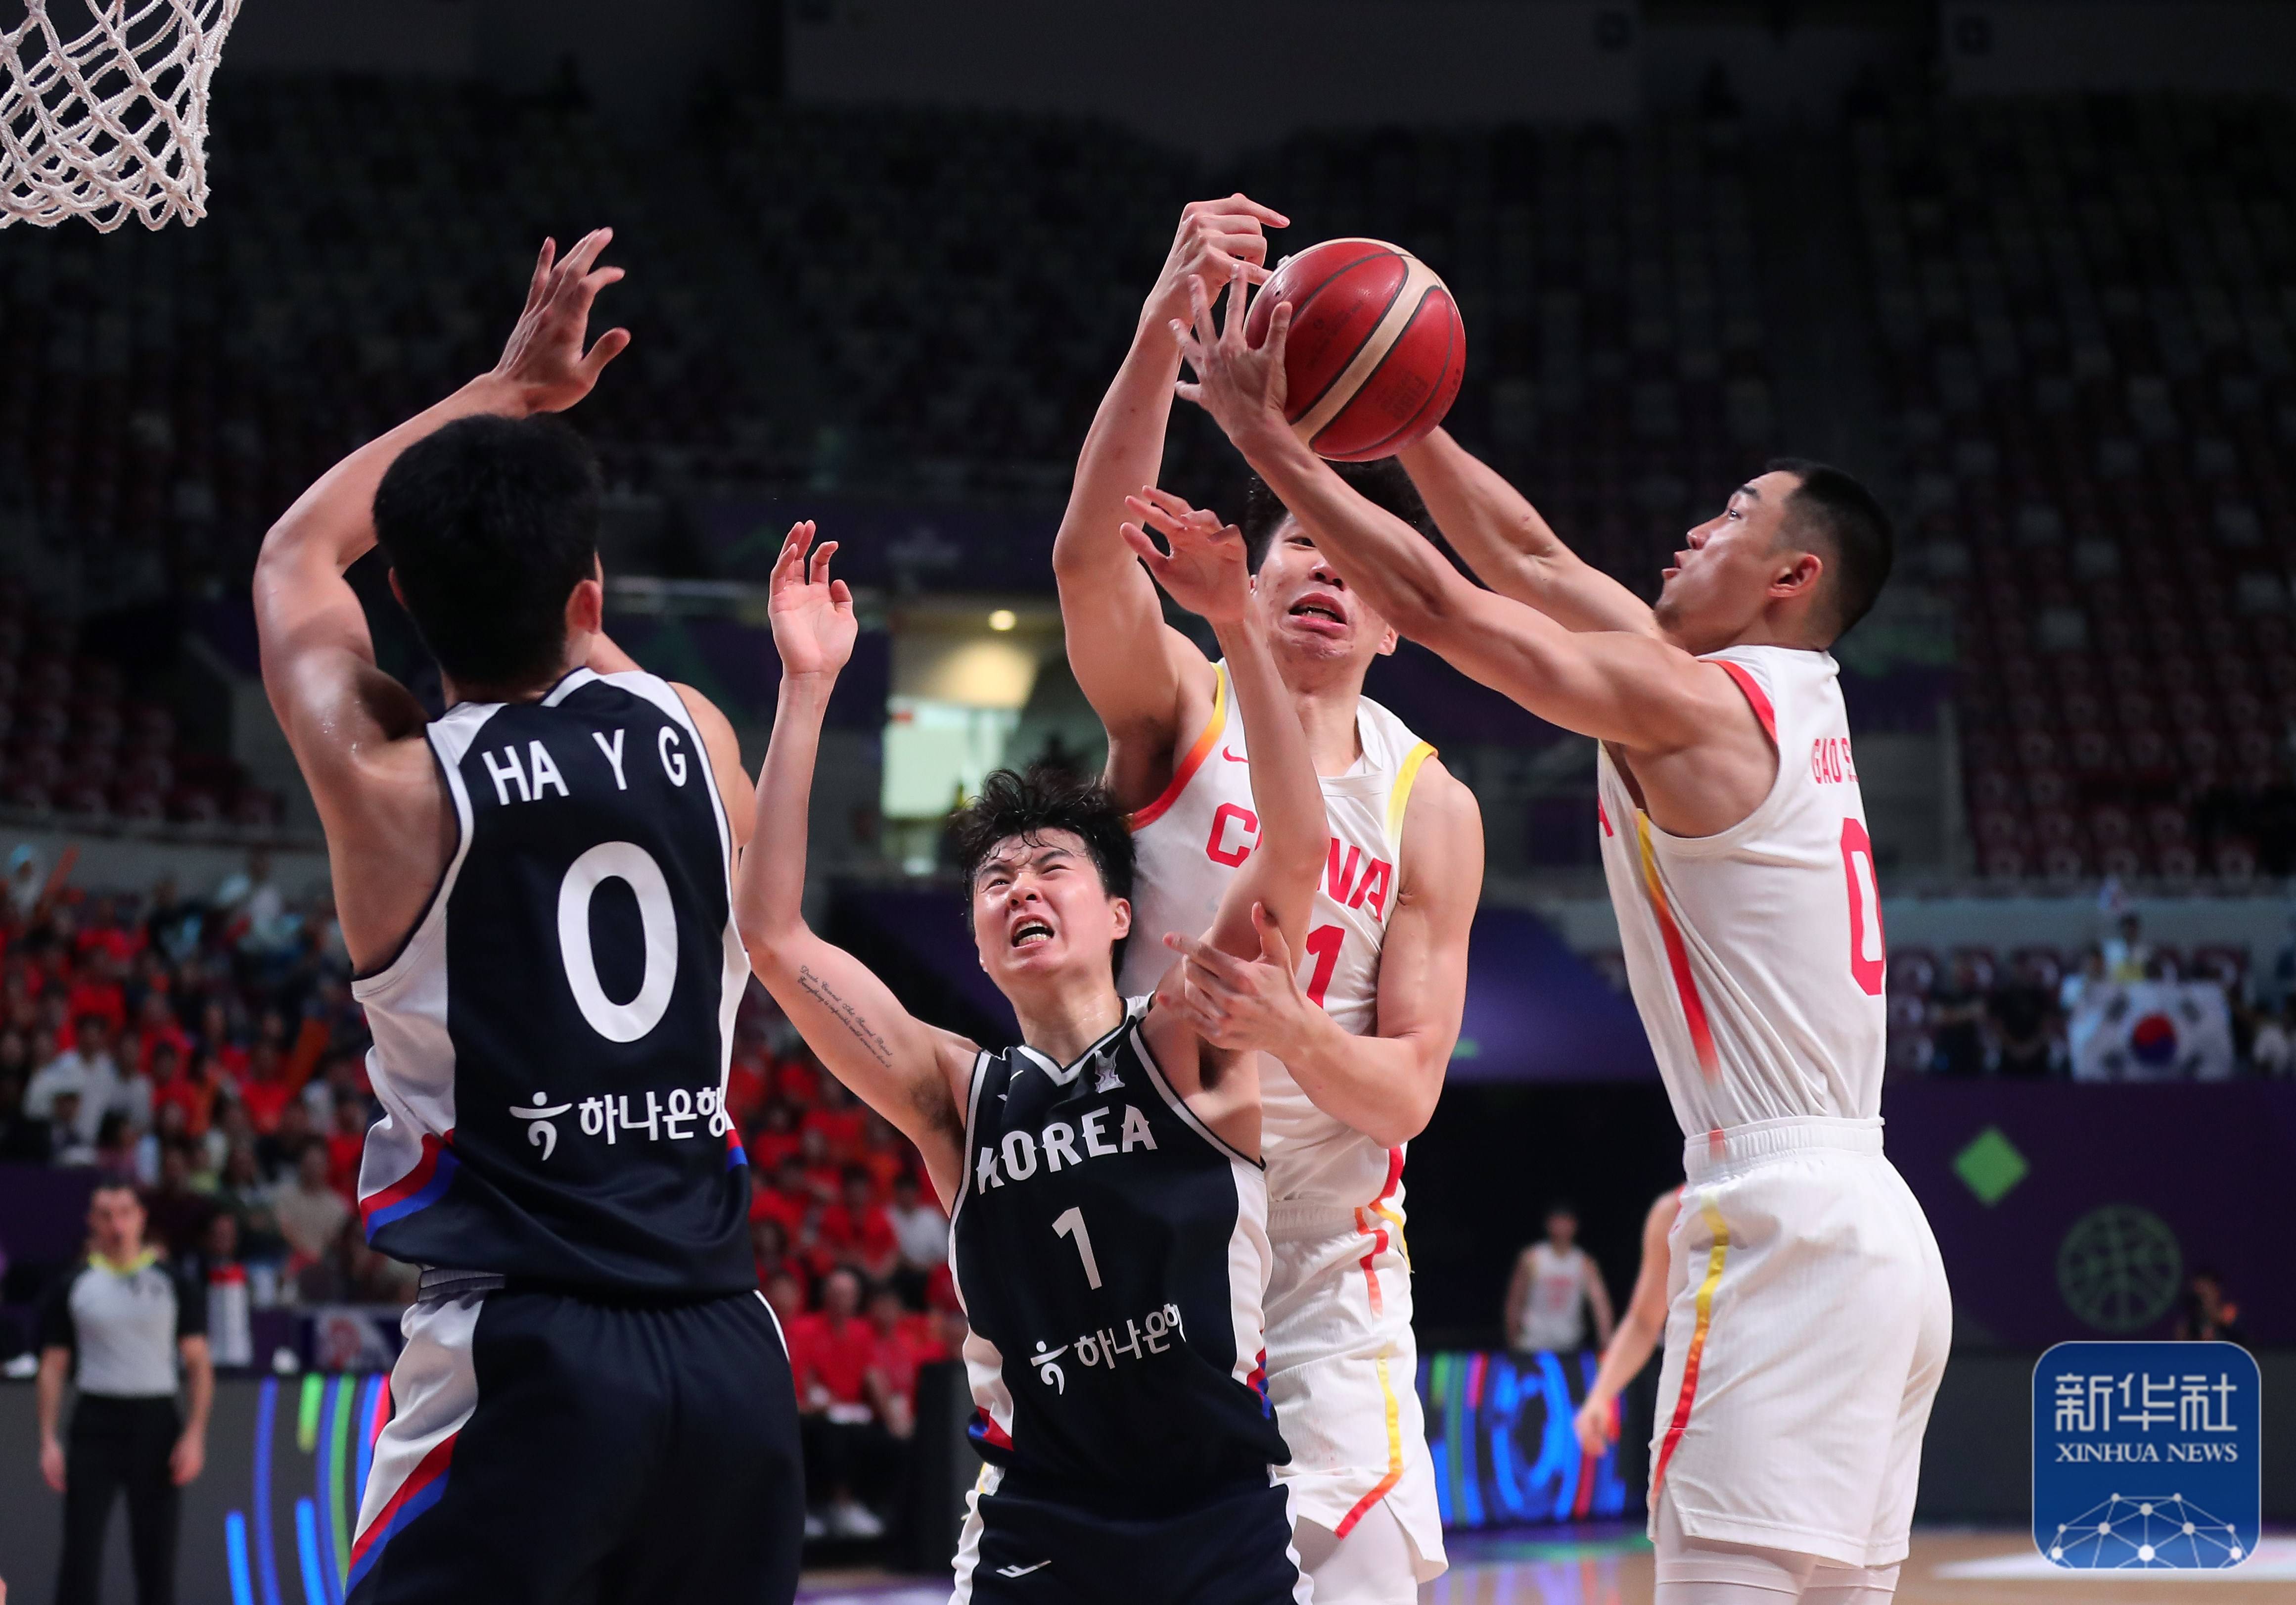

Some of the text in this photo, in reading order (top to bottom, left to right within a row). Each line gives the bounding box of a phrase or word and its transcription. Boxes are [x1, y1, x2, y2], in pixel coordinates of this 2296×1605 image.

[481, 726, 688, 805] HA Y G
[1811, 737, 1843, 784] GAO
[1205, 802, 1392, 923] CNA
[557, 841, 678, 1043] 0
[1839, 817, 1886, 996] 0
[578, 1086, 726, 1145] 하나은행
[976, 1104, 1158, 1195] KOREA
[1052, 1206, 1102, 1290] 1
